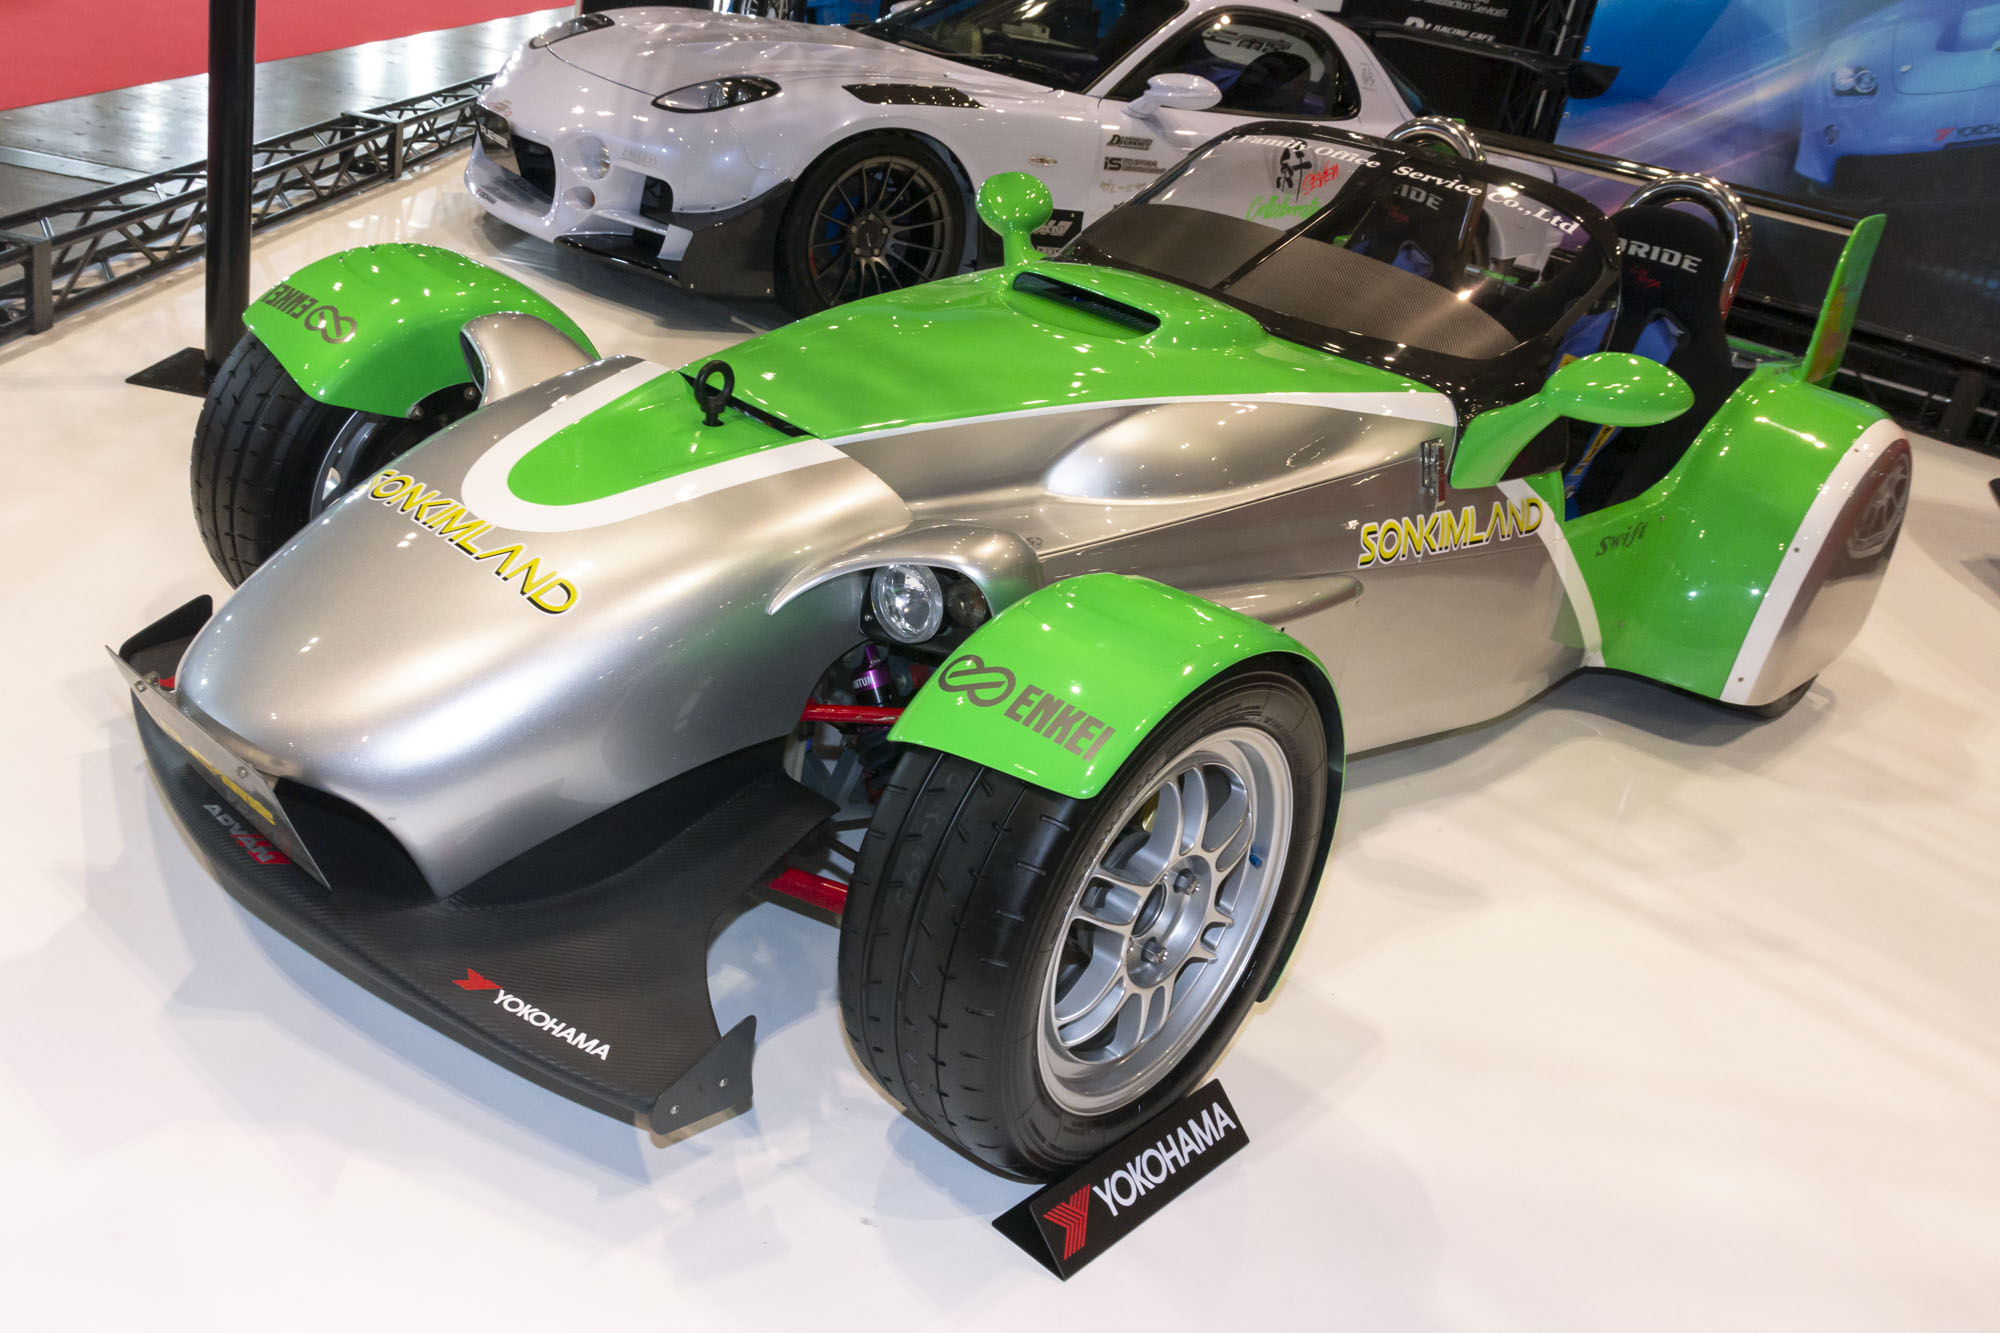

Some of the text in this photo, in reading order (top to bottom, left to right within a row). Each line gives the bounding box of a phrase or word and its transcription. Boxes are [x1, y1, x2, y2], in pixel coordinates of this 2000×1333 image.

[1238, 135, 1312, 153] Family
[1314, 145, 1381, 168] Office
[1393, 165, 1483, 196] Service
[1487, 190, 1581, 236] Co.,Ltd
[1301, 160, 1341, 197] SEVEN
[261, 283, 319, 319] ENKEI
[1358, 497, 1543, 569] SONKIMLAND
[1003, 684, 1116, 762] ENKEI
[202, 804, 276, 864] ADVAN
[493, 989, 611, 1061] YOKOHAMA
[1092, 1101, 1237, 1217] YOKOHAMA
